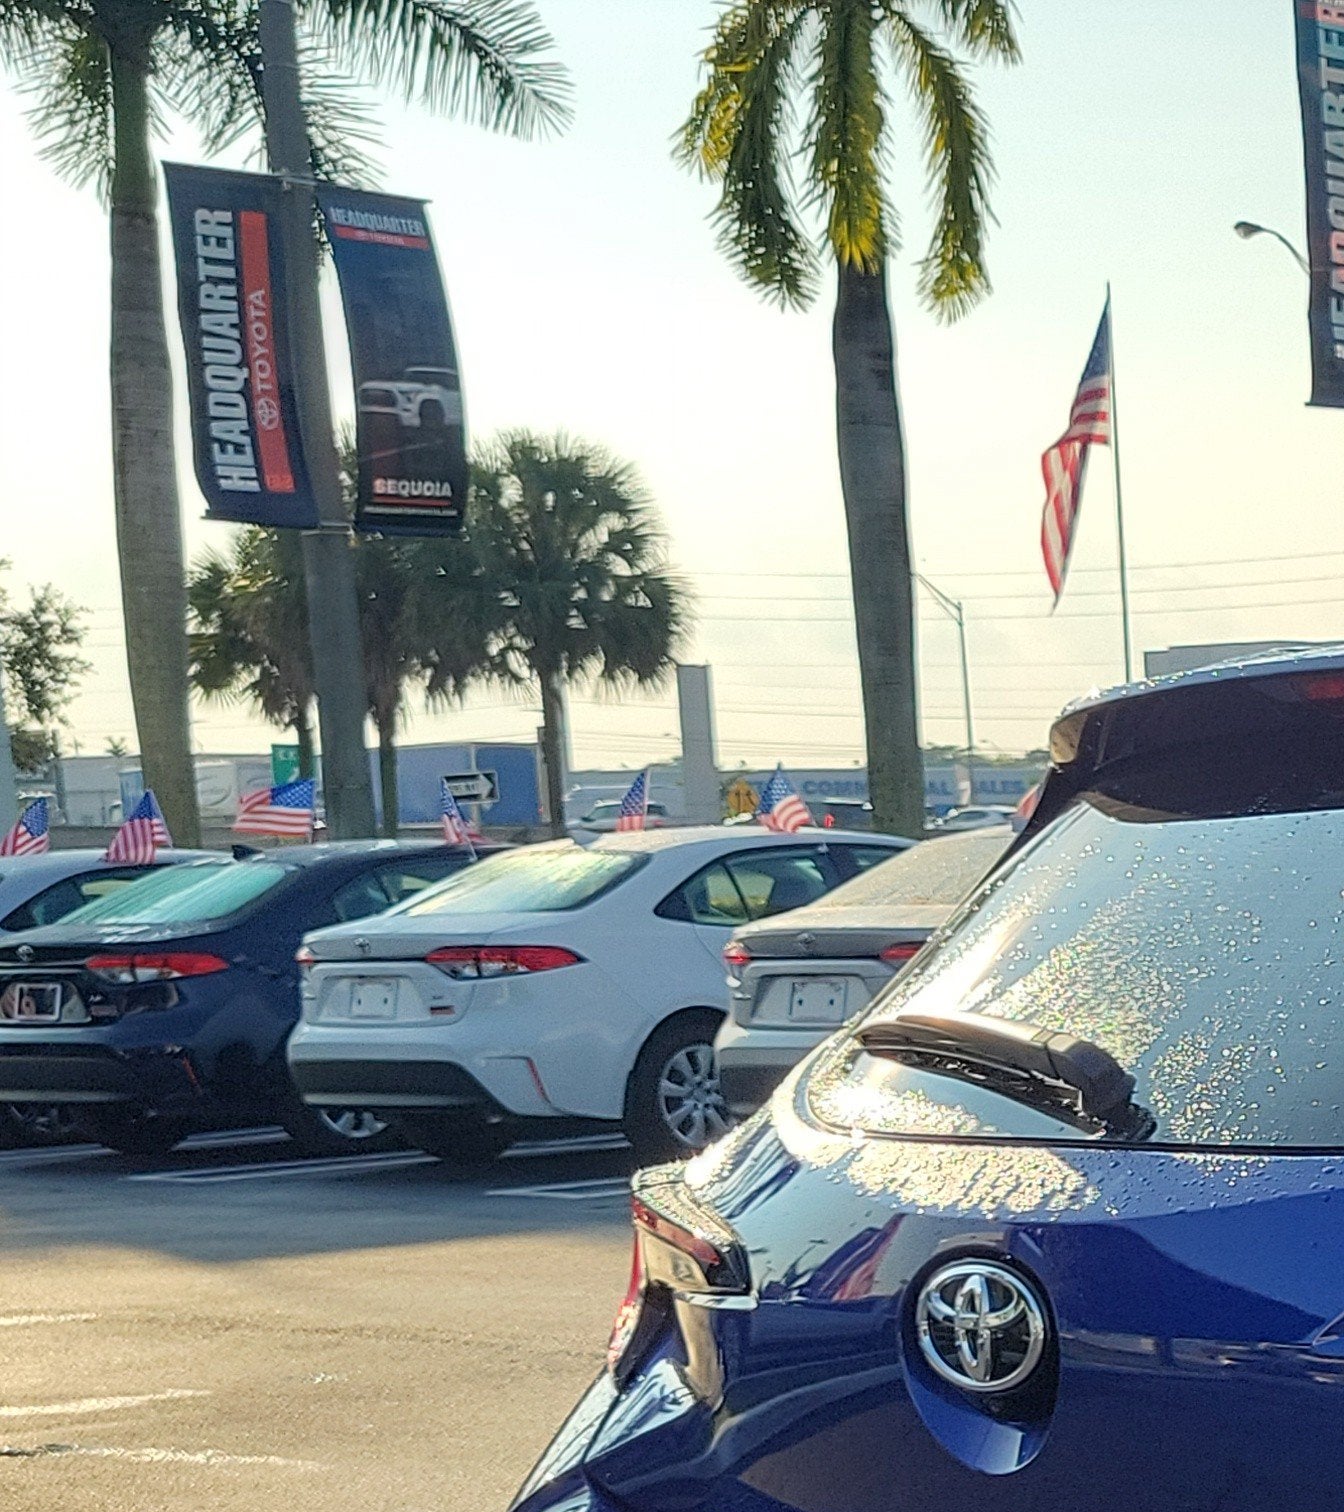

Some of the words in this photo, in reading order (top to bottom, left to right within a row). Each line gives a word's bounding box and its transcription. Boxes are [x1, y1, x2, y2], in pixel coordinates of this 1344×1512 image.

[195, 206, 262, 494] HEADQUARTER
[245, 289, 273, 393] TOYOTA
[373, 477, 453, 498] SEQUOIA
